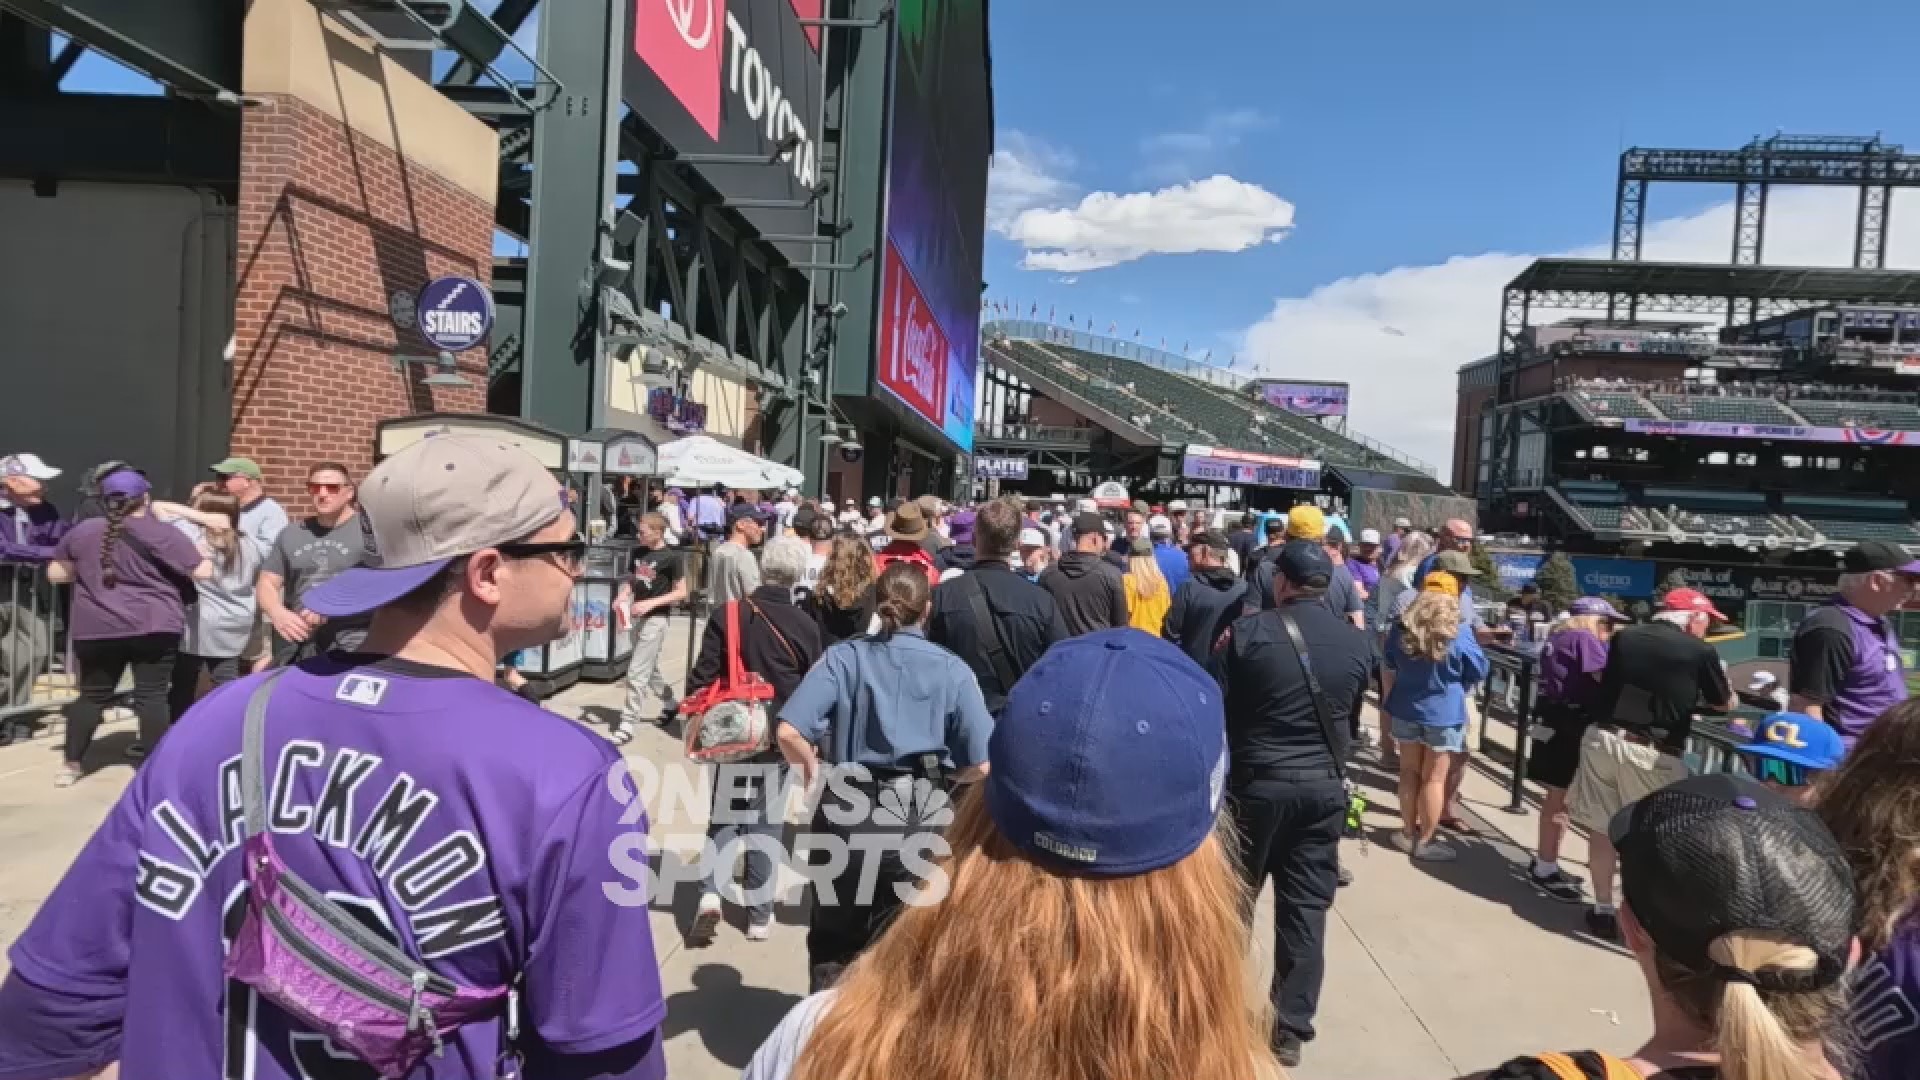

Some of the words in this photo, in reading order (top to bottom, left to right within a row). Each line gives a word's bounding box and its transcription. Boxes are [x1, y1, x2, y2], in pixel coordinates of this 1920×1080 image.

[726, 9, 815, 189] TOYOTA
[425, 309, 482, 335] STAIRS
[1715, 568, 1734, 582] of
[135, 739, 506, 959] BLACKMON
[1033, 831, 1097, 863] COLORADO
